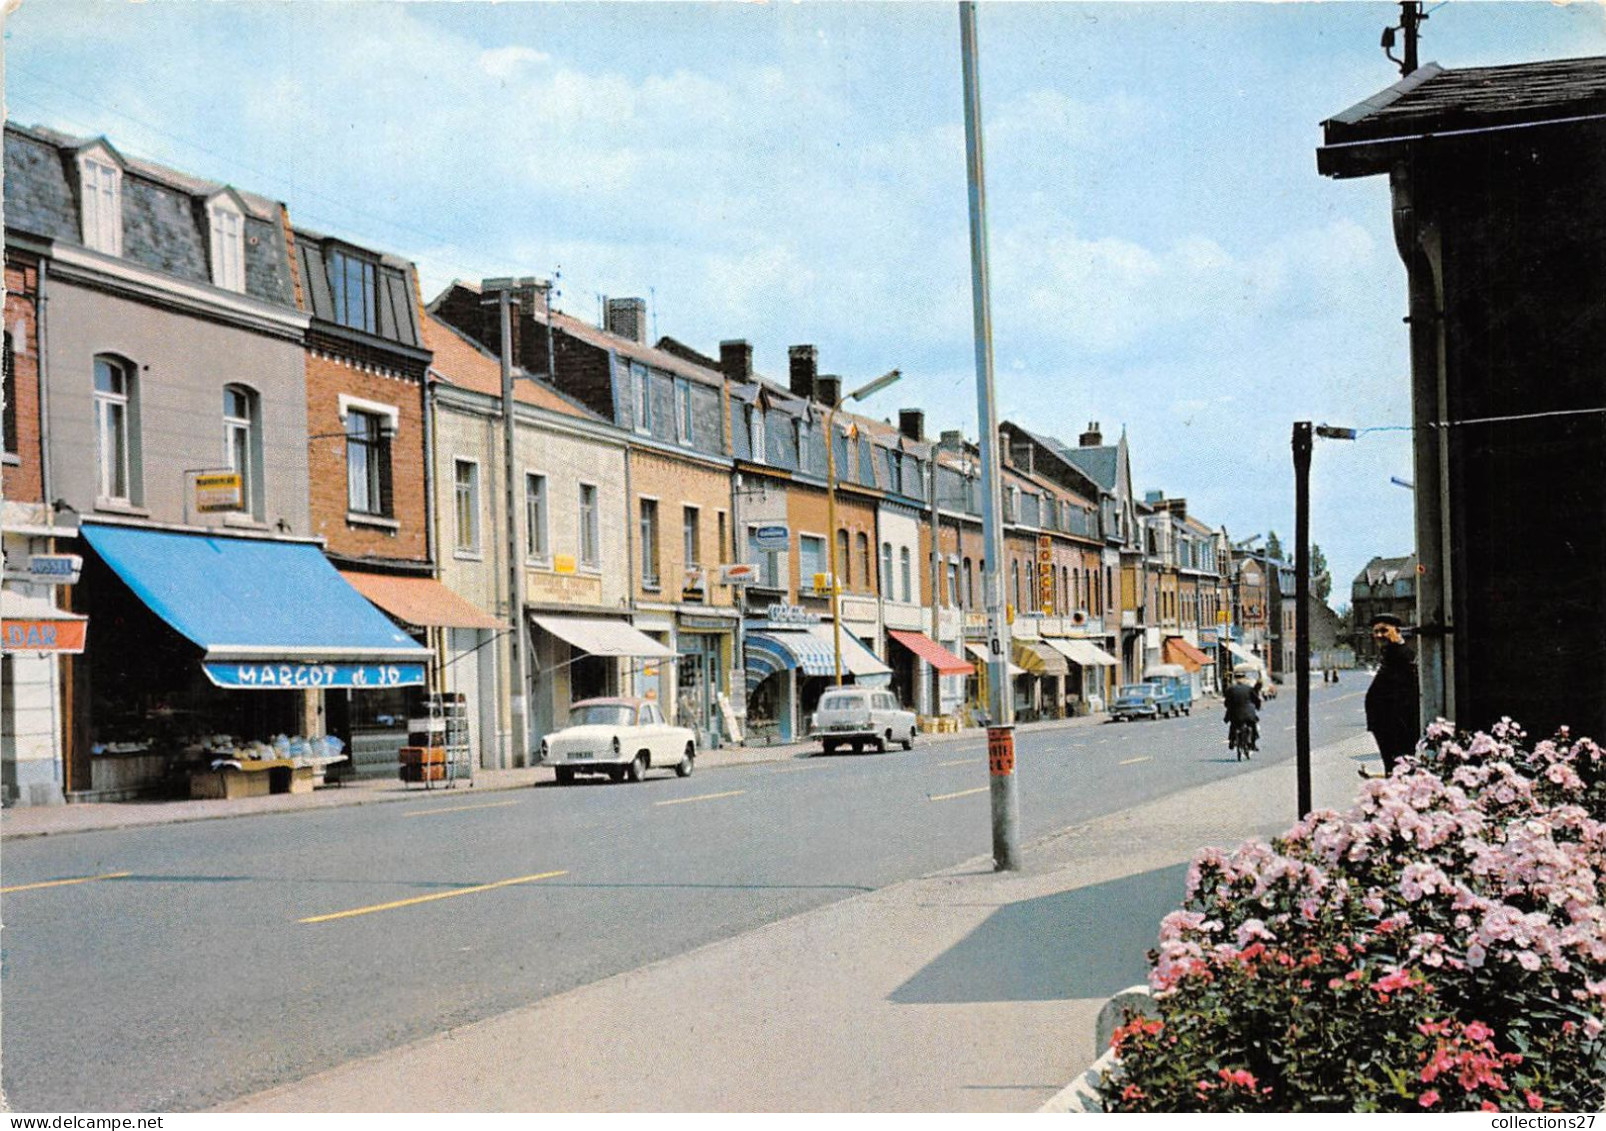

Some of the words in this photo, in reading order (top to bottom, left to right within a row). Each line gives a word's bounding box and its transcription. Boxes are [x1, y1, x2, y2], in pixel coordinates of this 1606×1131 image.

[1041, 536, 1051, 601] BOSCH
[2, 625, 56, 647] DAR
[238, 664, 337, 687] MARGOT
[352, 668, 367, 687] et
[378, 665, 400, 685] JO
